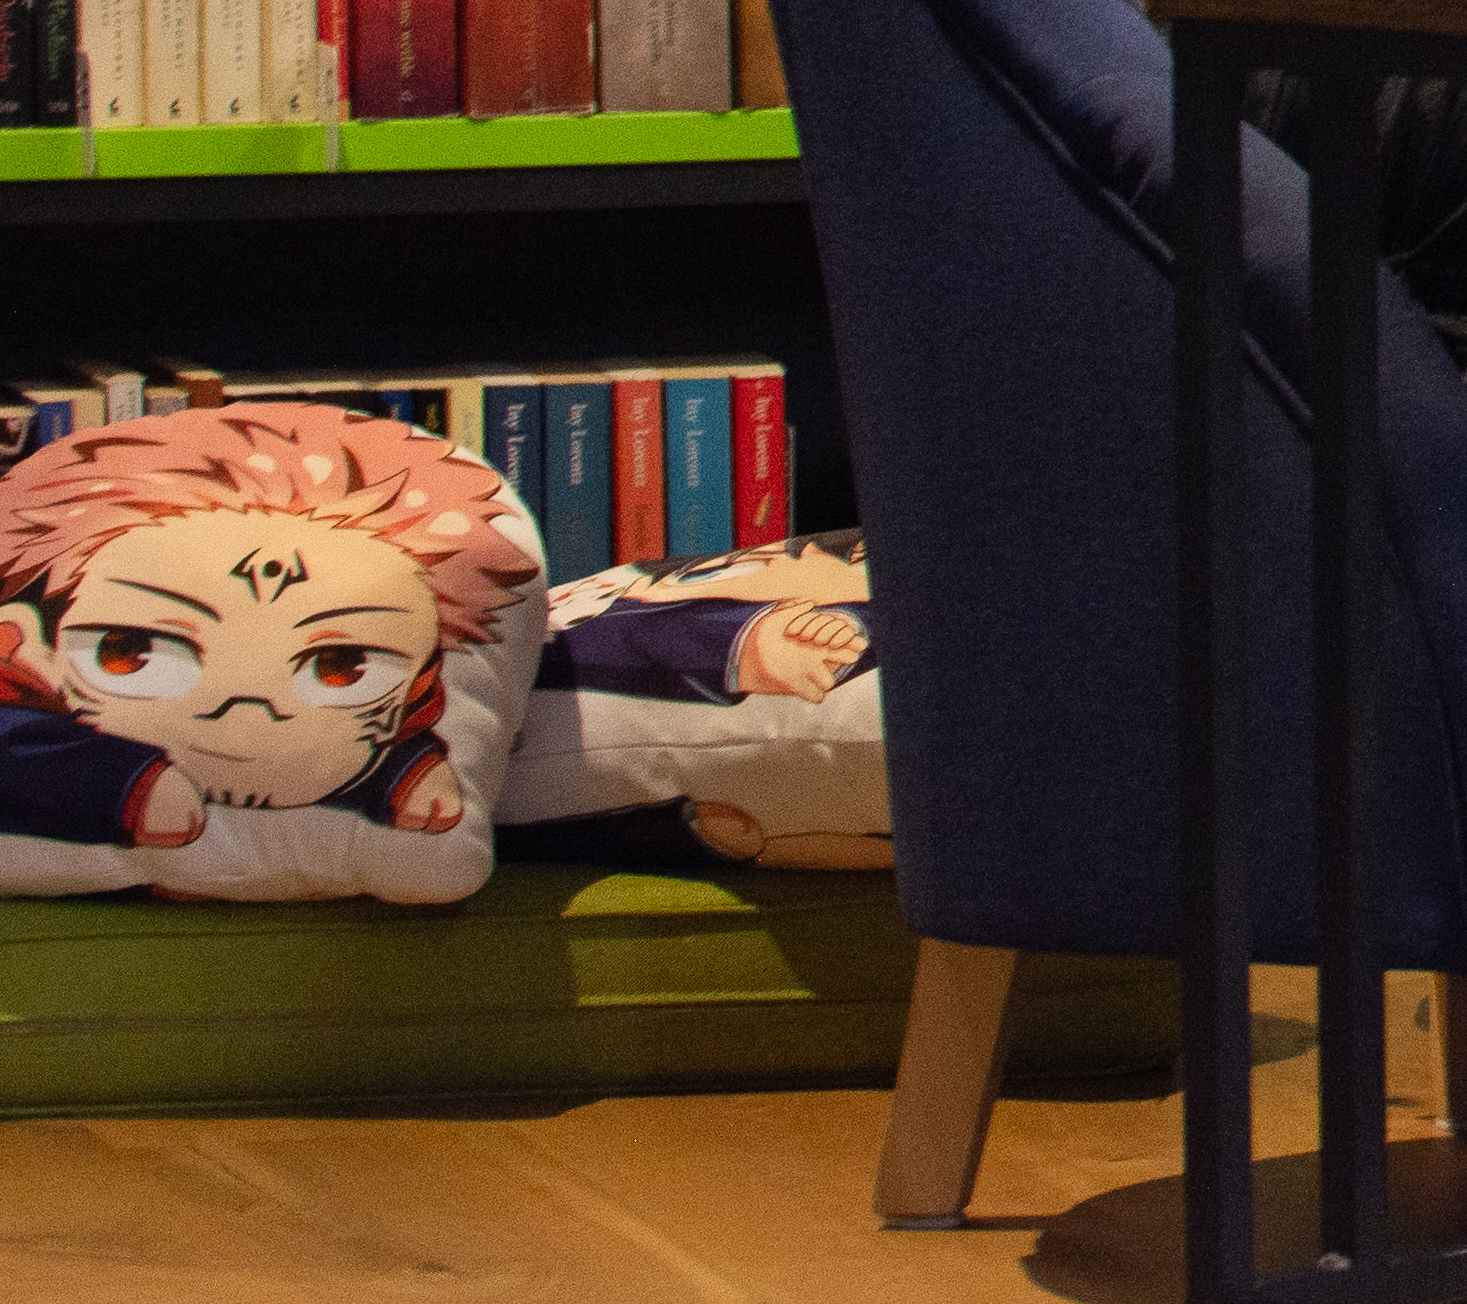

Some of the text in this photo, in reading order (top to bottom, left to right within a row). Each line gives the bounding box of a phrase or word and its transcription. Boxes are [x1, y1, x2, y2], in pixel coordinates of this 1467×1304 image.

[566, 404, 587, 485] Iny Lorentz
[629, 397, 650, 487] Iny Lorentz
[684, 399, 703, 488] Iny Lorentz
[751, 398, 773, 480] Iny Lorentz
